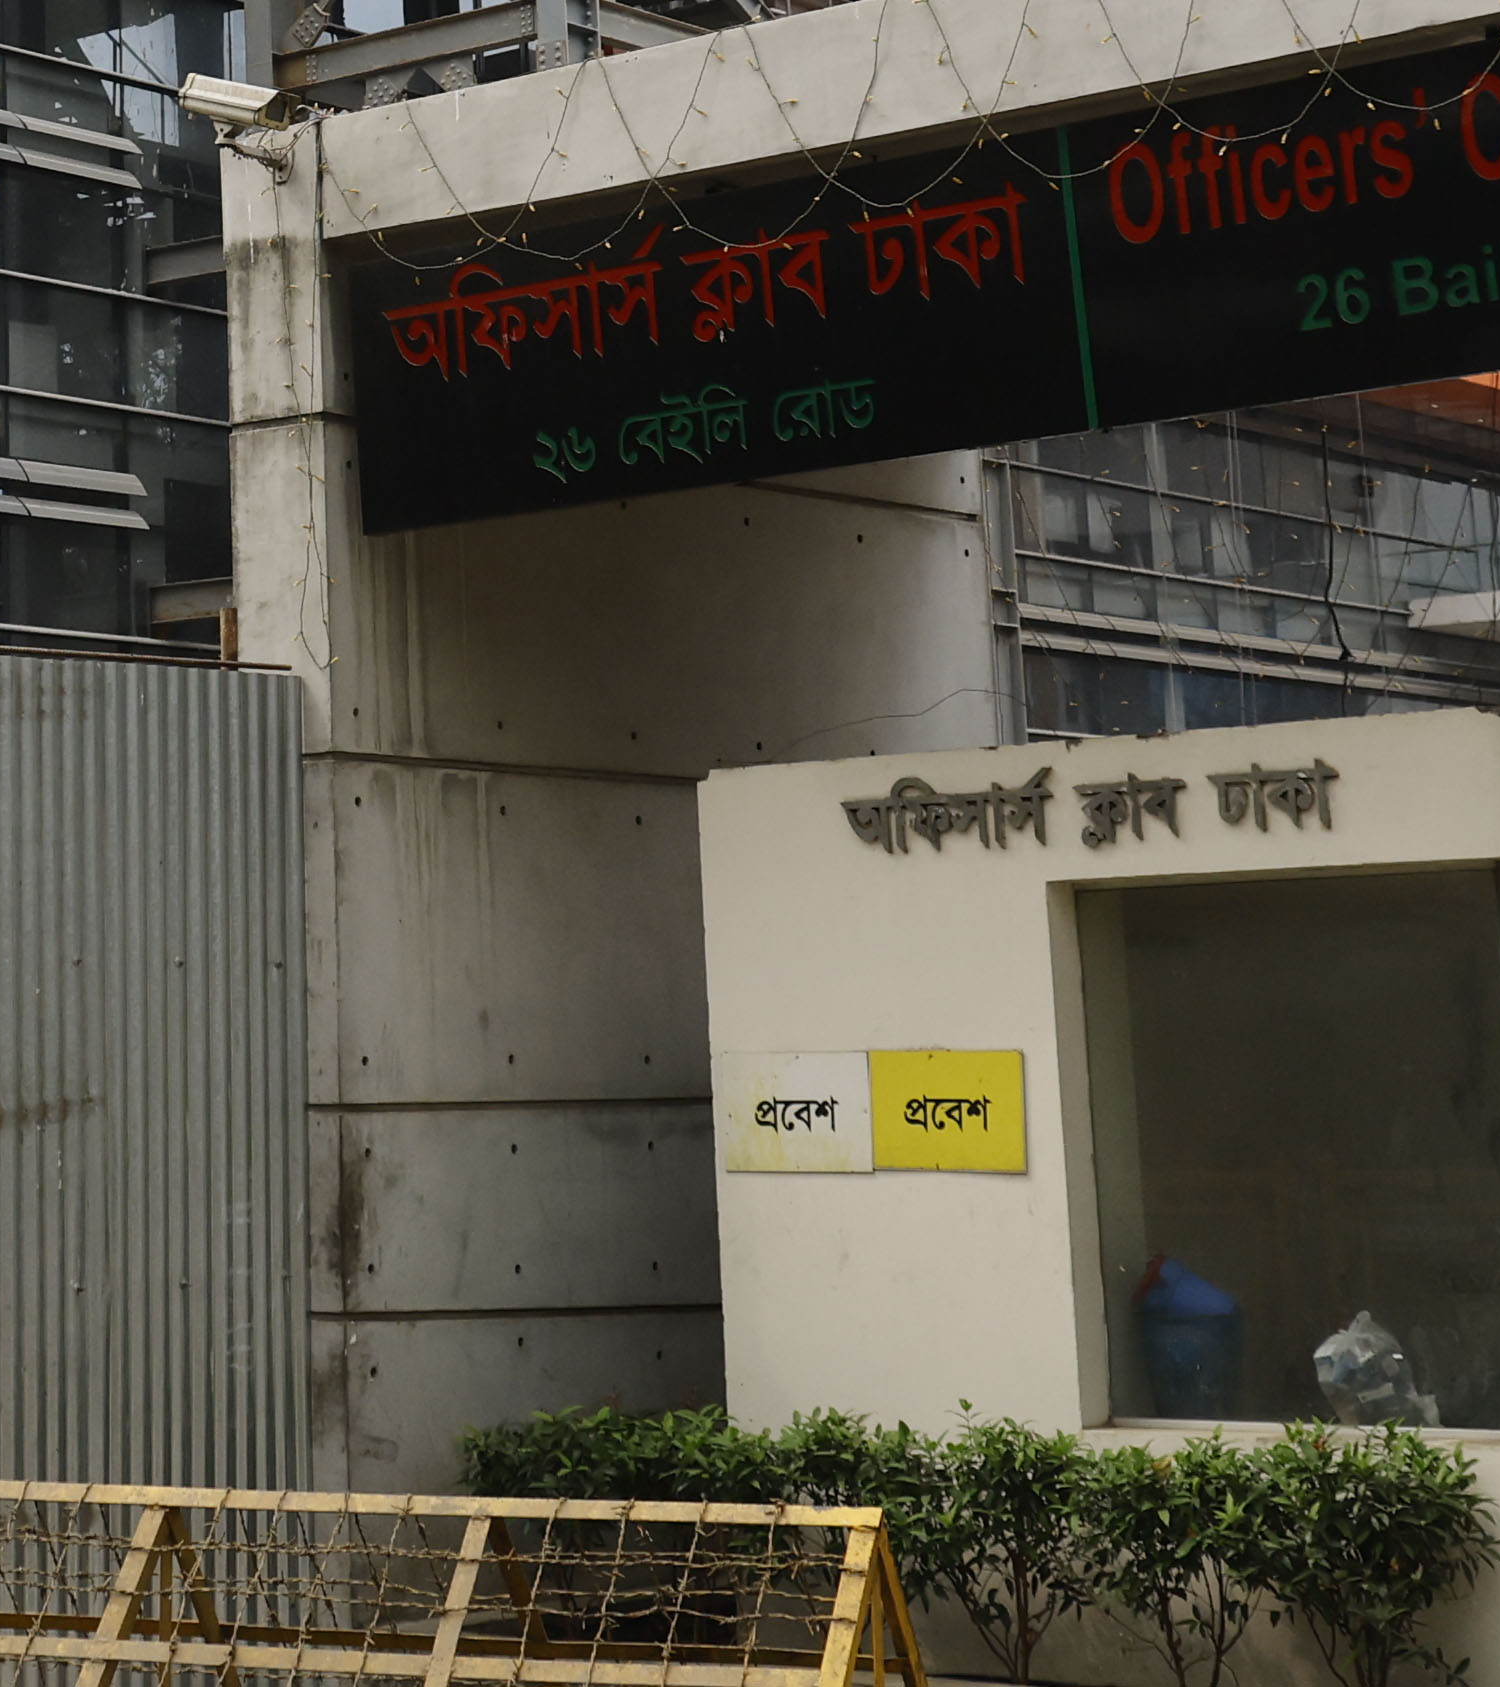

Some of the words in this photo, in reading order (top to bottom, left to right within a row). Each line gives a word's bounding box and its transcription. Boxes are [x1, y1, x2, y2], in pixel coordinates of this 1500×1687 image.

[1107, 87, 1427, 245] Officers'
[382, 224, 663, 382] অফিসার্স
[681, 229, 830, 340] ক্লাব
[848, 182, 1028, 301] ঢাকা
[1297, 267, 1372, 331] 26
[533, 426, 597, 485] ২৬
[619, 385, 748, 465] বেইলি
[773, 377, 876, 441] রোড
[841, 766, 1054, 855] অফিসার্স
[1072, 772, 1187, 849] ক্লাব
[1206, 757, 1340, 834] ঢাকা
[755, 1096, 839, 1134] প্রবেশ
[904, 1094, 992, 1133] প্রবেশ
